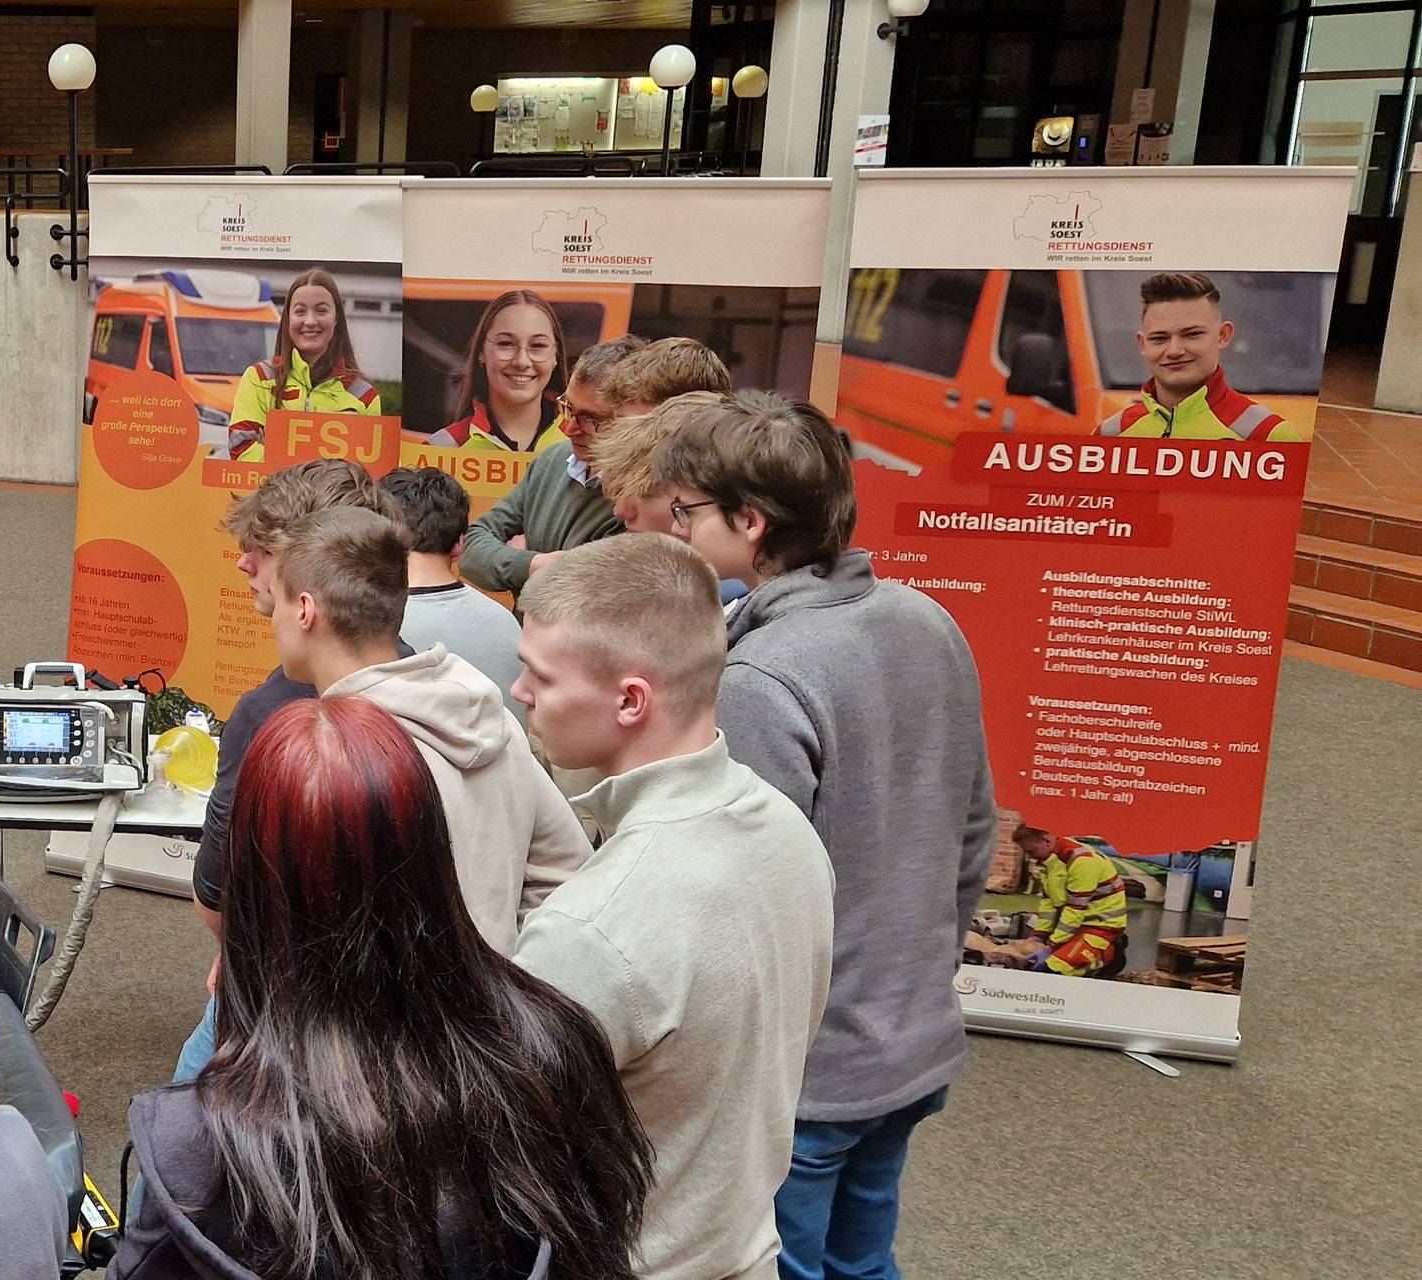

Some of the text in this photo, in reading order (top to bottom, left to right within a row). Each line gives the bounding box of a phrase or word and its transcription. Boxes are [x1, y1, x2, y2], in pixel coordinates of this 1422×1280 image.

[1050, 220, 1084, 229] KREIS
[220, 234, 292, 244] RETTUNGSDIENST
[564, 235, 592, 243] KREIS
[1050, 230, 1083, 238] SOEST
[563, 244, 592, 252] SOEST
[1048, 242, 1154, 251] RETTUNGSDIENST
[562, 255, 654, 265] RETTUNGSDIENST
[1046, 254, 1064, 262] WIR
[611, 268, 630, 276] Kreis
[632, 268, 652, 276] Soest
[122, 395, 141, 406] weil
[142, 396, 158, 406] ich
[160, 397, 182, 408] dort
[132, 409, 154, 419] eine
[101, 421, 188, 436] große Perspektive
[128, 436, 155, 446] sehe!
[286, 419, 383, 464] FSJ
[416, 453, 530, 485] AUSBI
[983, 442, 1288, 481] AUSBILDUNG
[222, 468, 242, 485] im
[1026, 493, 1116, 510] ZUM / ZUR
[881, 550, 890, 560] 3
[892, 550, 928, 563] Jahre
[78, 563, 165, 584] Voraussetzungen:
[1042, 570, 1212, 591] Ausbildungsabschnitte:
[907, 576, 987, 593] Ausbildung:
[220, 588, 255, 600] Einsatz
[1052, 586, 1232, 609] theoretische Ausbildung:
[88, 596, 98, 606] 16
[99, 598, 130, 610] Jahren
[219, 600, 256, 614] Rettung
[94, 610, 157, 626] Hauptschulab-
[218, 612, 233, 622] Als
[1050, 600, 1237, 624] Rettungsdienstschule StiWL
[104, 623, 128, 635] (oder
[130, 627, 187, 644] gleichwertig)
[218, 625, 240, 635] KTW
[244, 628, 256, 637] im
[1049, 616, 1272, 642] klinisch-praktische Ausbildung:
[74, 632, 141, 648] Freischwimmer-
[216, 637, 256, 649] transport
[1048, 630, 1272, 656] Lehrkrankenhäuser im Kreis Soest
[140, 655, 177, 668] Bronze)
[1046, 646, 1210, 668] praktische Ausbildung:
[1043, 660, 1258, 686] Lehrrettungswachen des Kreises
[214, 685, 242, 697] Rettun
[1028, 694, 1153, 716] Voraussetzungen:
[1038, 710, 1163, 732] Fachoberschulreife
[1036, 726, 1261, 754] oder Hauptschulabschluss + mind.
[1113, 747, 1222, 767] abgeschlossene
[1033, 755, 1146, 776] Berufsausbildung
[1032, 770, 1206, 796] Deutsches Sportabzeichen
[1030, 784, 1134, 806] (max. 1 Jahr alt)
